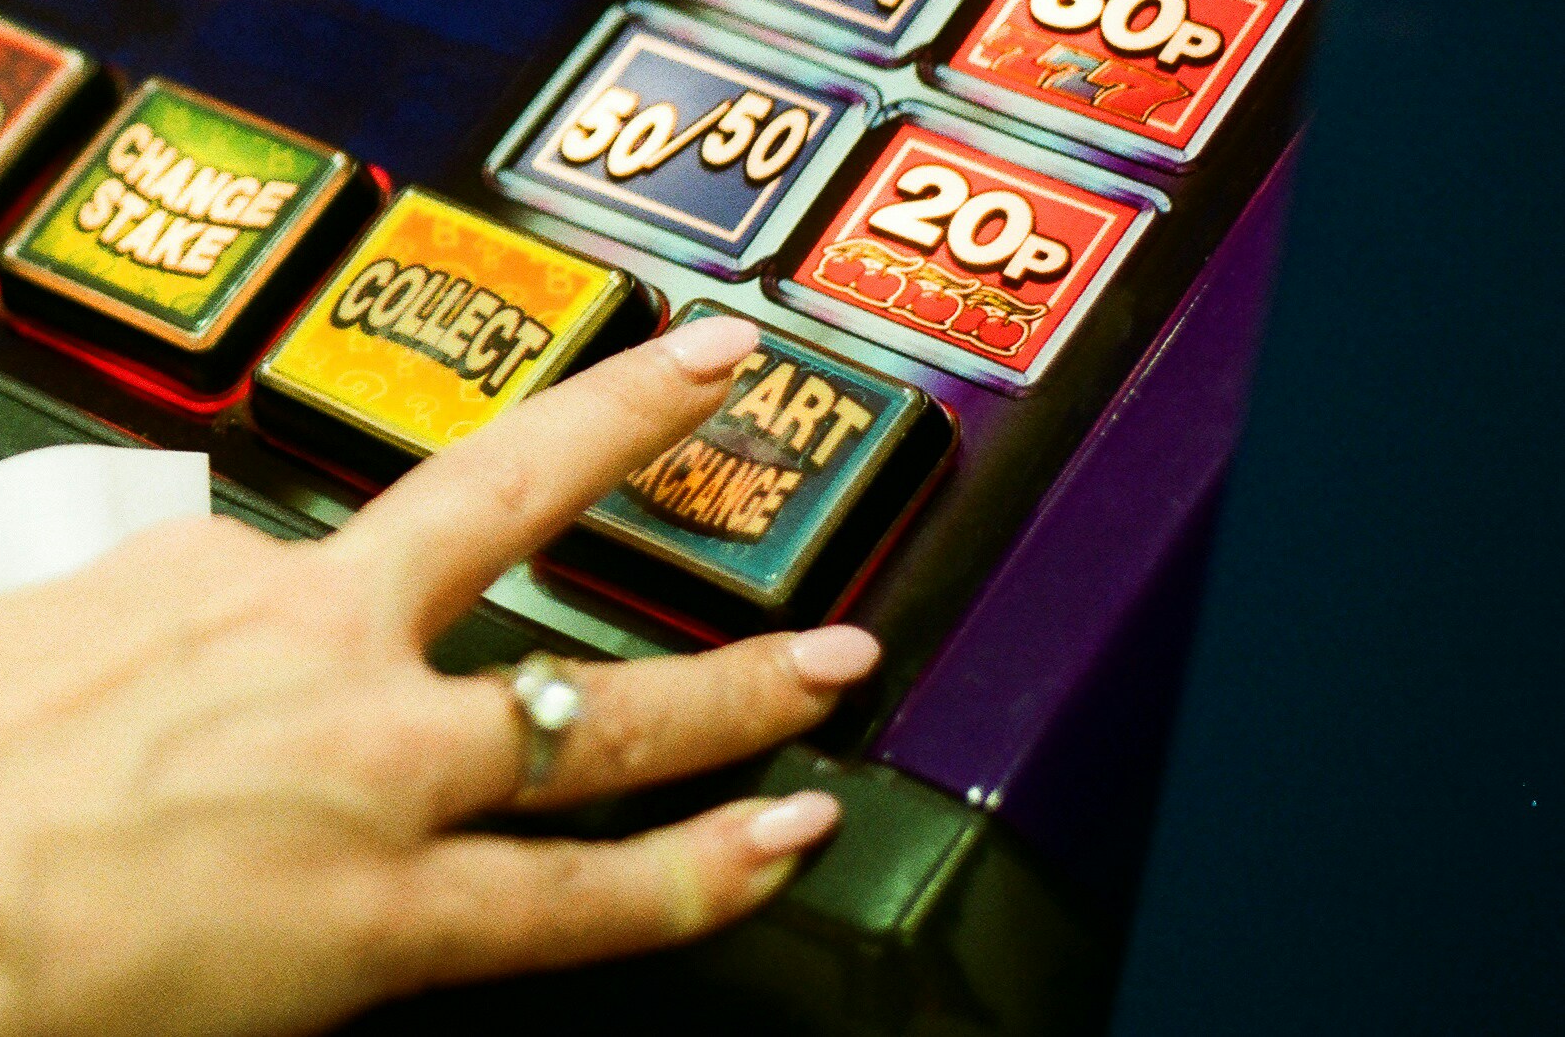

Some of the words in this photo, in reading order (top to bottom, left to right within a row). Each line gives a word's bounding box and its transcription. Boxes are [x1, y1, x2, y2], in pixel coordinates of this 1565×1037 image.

[107, 119, 301, 230] CHANGE
[557, 87, 811, 186] 50/50
[75, 174, 243, 278] STAKE
[328, 256, 557, 396] COLLECT
[728, 350, 875, 470] ART
[625, 434, 805, 538] XCHANGE
